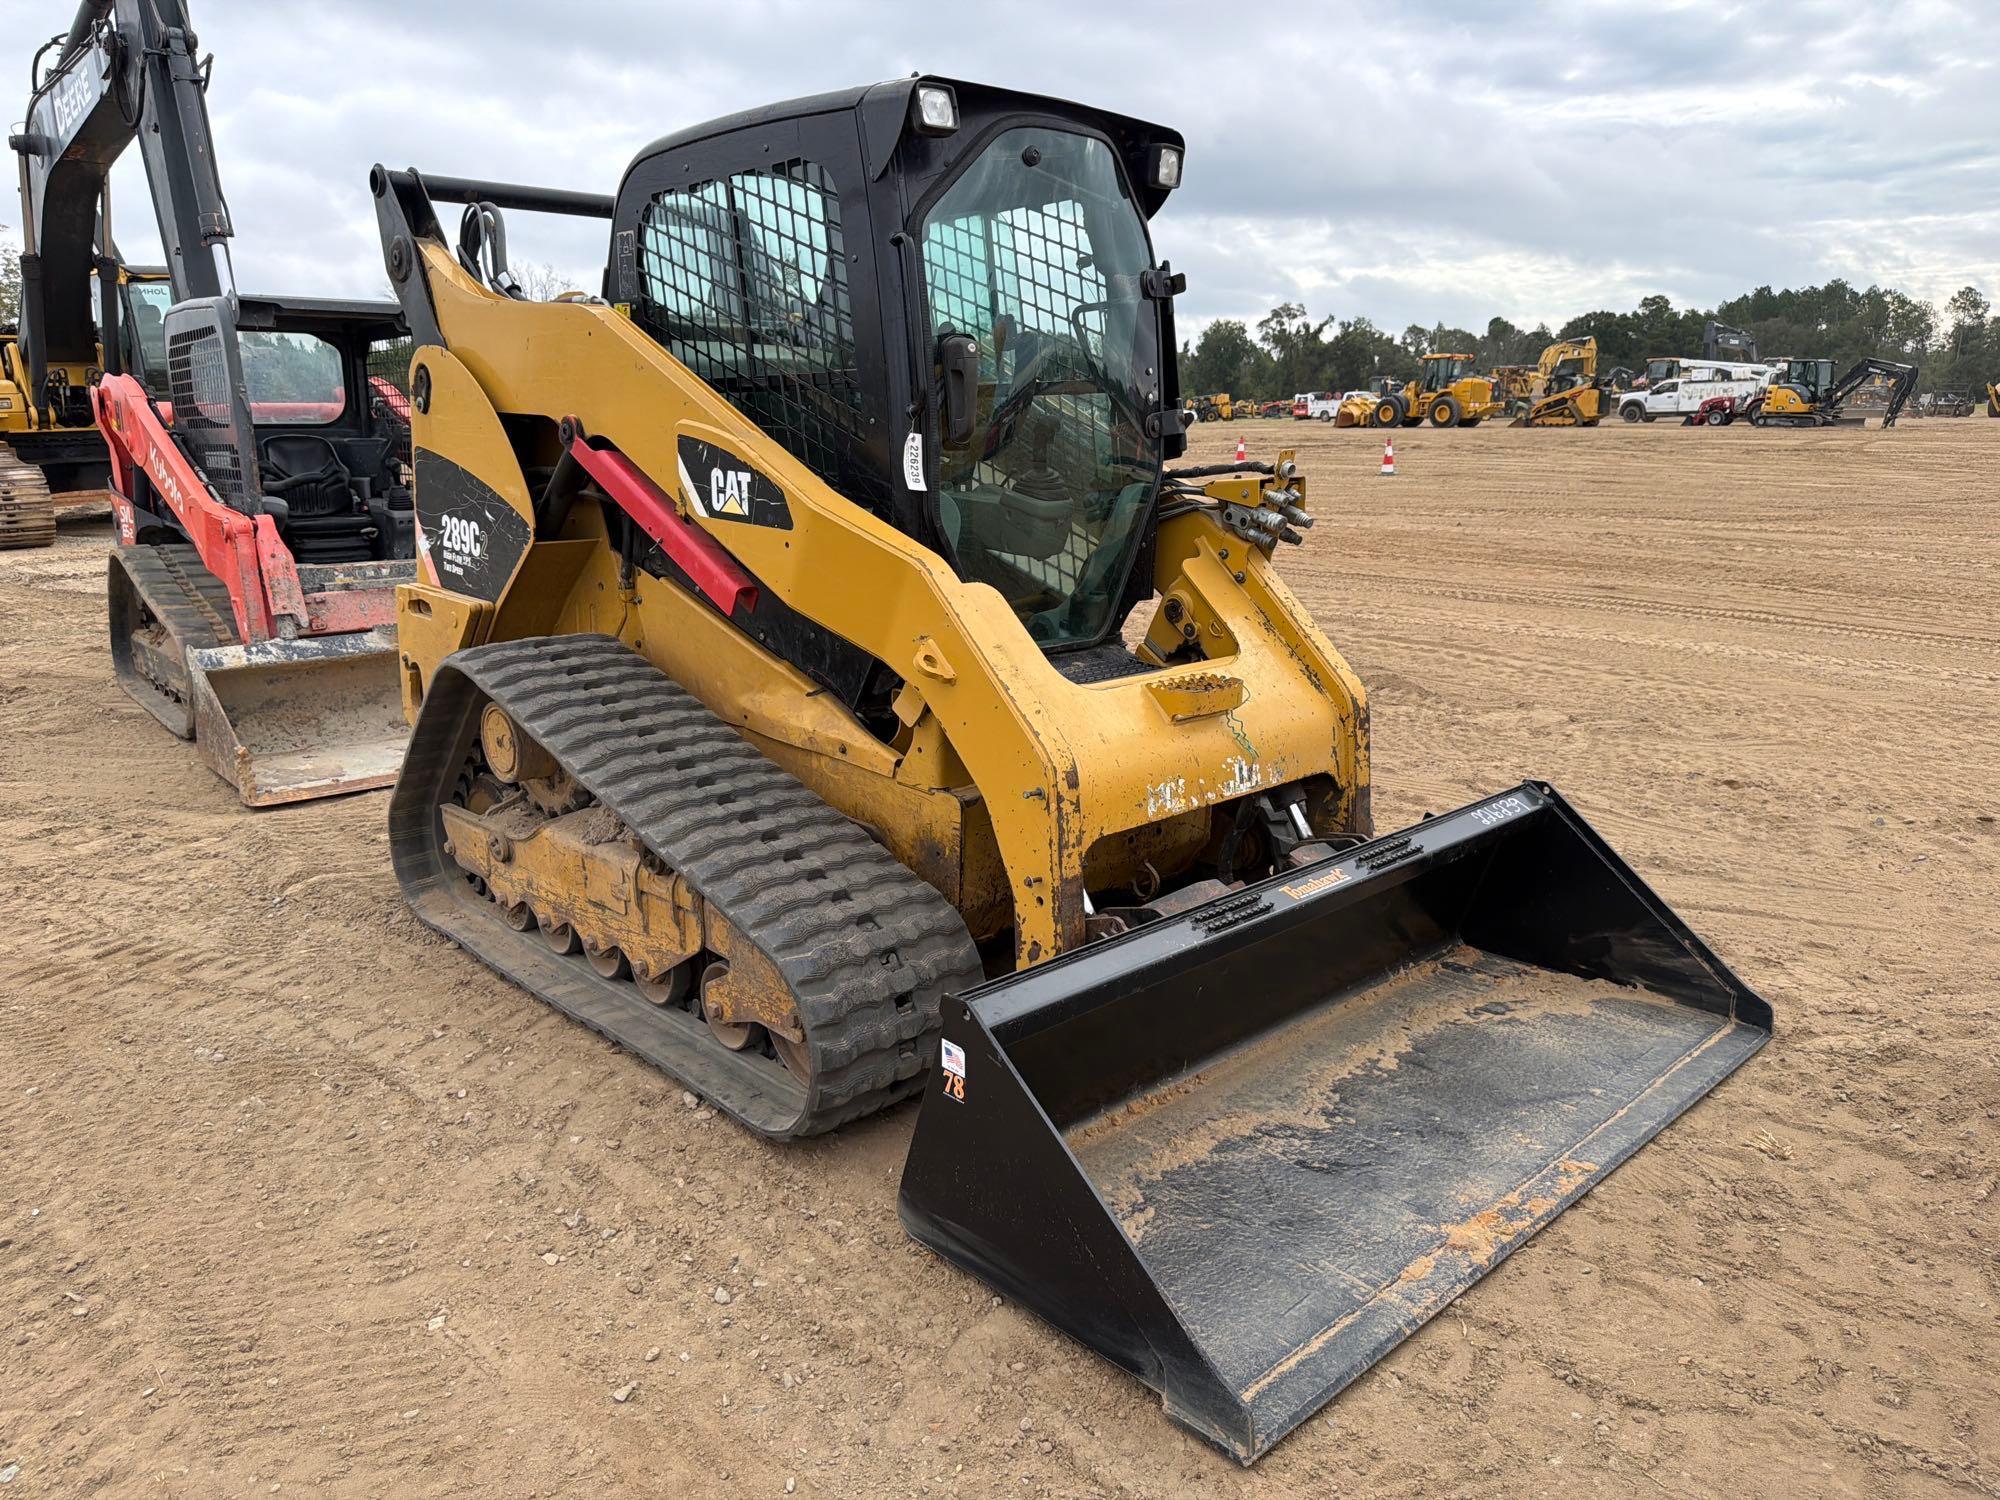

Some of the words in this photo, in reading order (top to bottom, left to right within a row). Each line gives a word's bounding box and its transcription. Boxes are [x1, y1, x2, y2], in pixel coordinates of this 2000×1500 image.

[53, 66, 93, 137] DEERE
[149, 441, 184, 514] Kubota
[910, 445, 921, 484] 226239
[710, 466, 752, 517] CAT
[942, 1069, 965, 1100] 78
